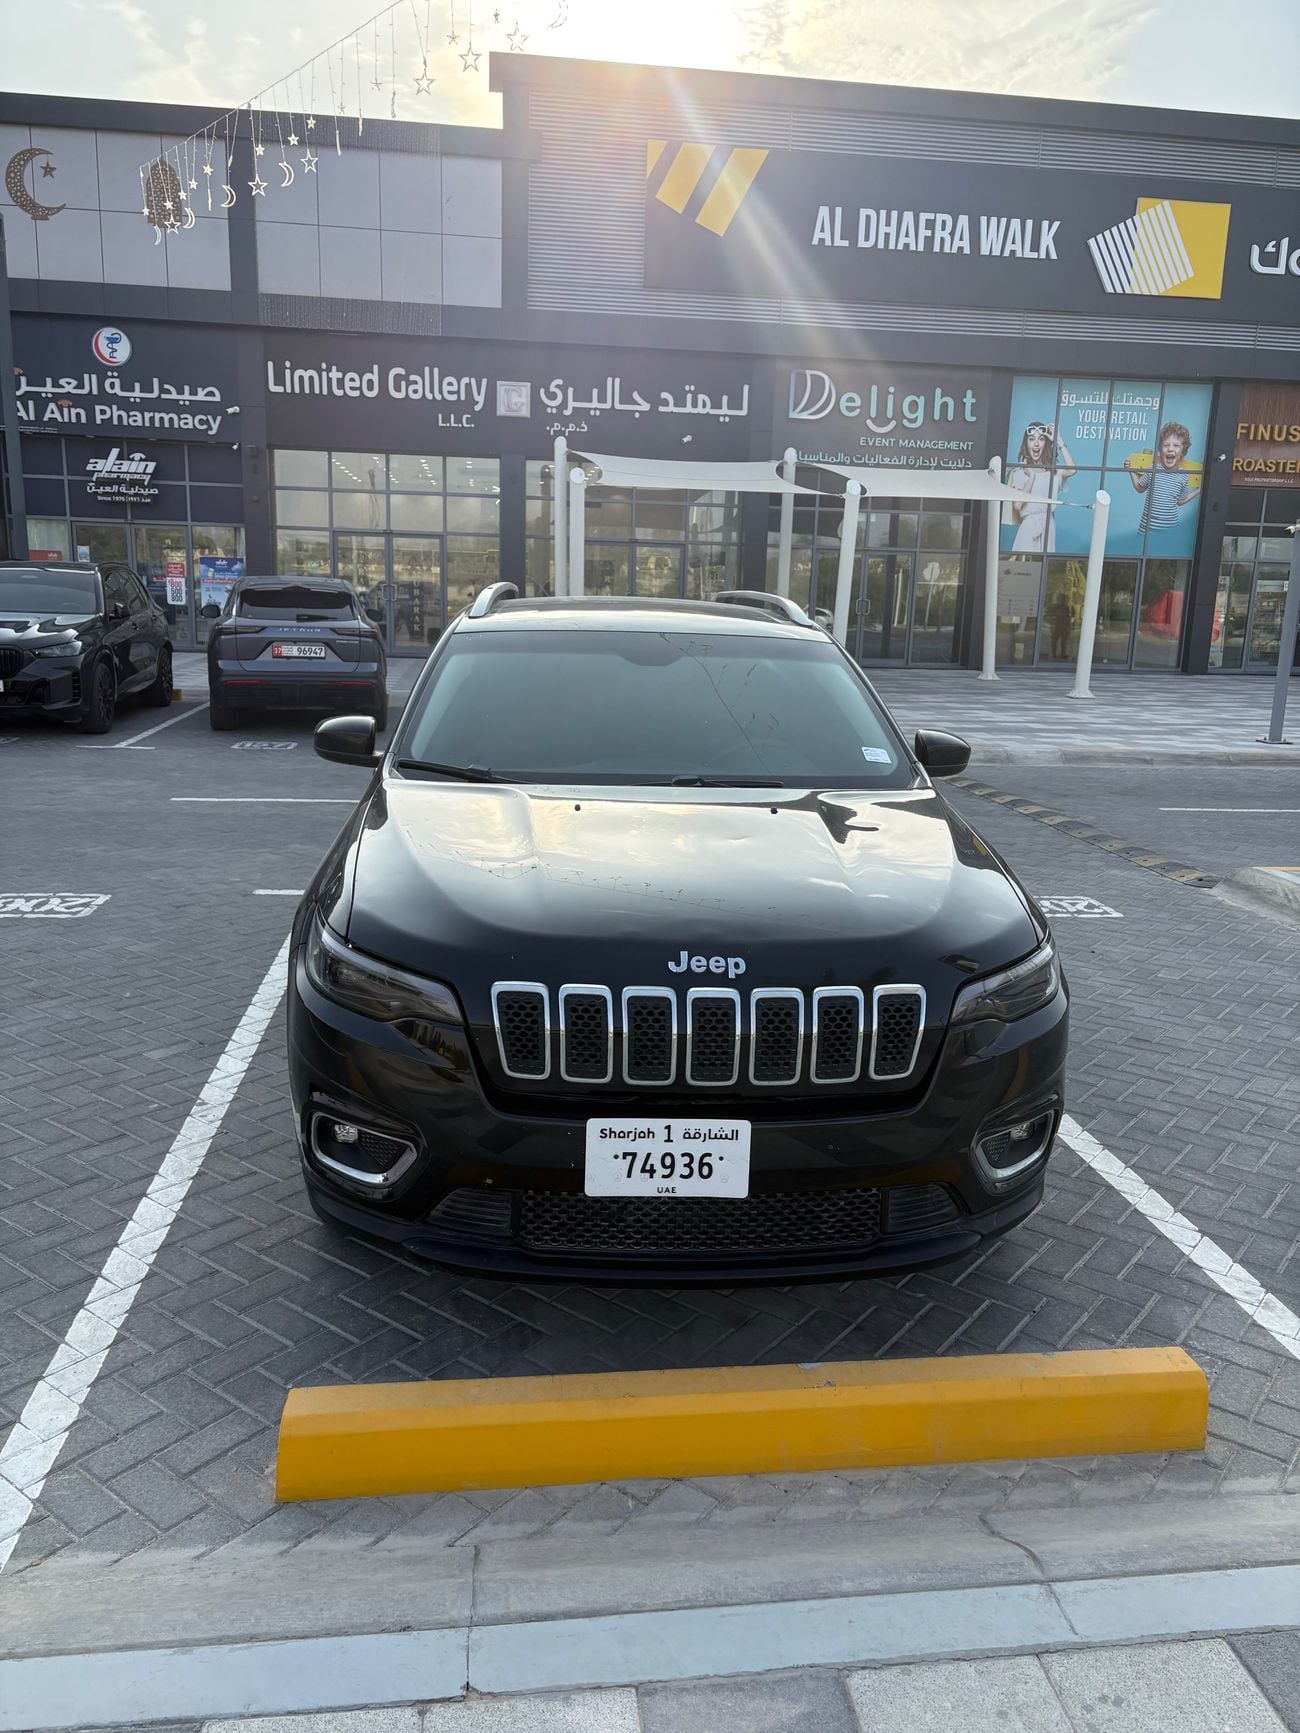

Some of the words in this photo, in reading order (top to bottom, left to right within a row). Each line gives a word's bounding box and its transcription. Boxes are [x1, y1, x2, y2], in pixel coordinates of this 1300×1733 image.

[811, 205, 849, 247] AL
[857, 208, 971, 254] DHAFRA
[979, 215, 1062, 260] WALK
[104, 371, 221, 405] صيدلية
[267, 360, 379, 398] Limited
[388, 366, 488, 411] Gallery
[539, 377, 651, 418] جاليري
[658, 384, 750, 422] ليمتد
[789, 370, 977, 430] Delight
[1060, 390, 1109, 407] للتسوق
[42, 400, 87, 423] Ain
[94, 404, 222, 435] Pharmacy
[438, 413, 475, 428] L.L.C.
[1078, 409, 1106, 423] YOUR
[1111, 411, 1148, 425] RETAIL
[1076, 425, 1147, 441] DESTINATION
[860, 437, 895, 447] EVENT
[899, 439, 974, 451] MANAGEMENT
[852, 453, 907, 467] الفعاليات
[92, 472, 152, 486] pharmacy
[86, 482, 119, 494] العين
[119, 483, 159, 496] صيدلية
[297, 646, 324, 656] 96947
[667, 950, 746, 979] Jeep
[599, 1127, 655, 1142] Sharjah
[663, 1124, 674, 1143] 1
[682, 1127, 739, 1142] الشارقة
[621, 1151, 714, 1180] 74936
[656, 1186, 677, 1194] UAE
